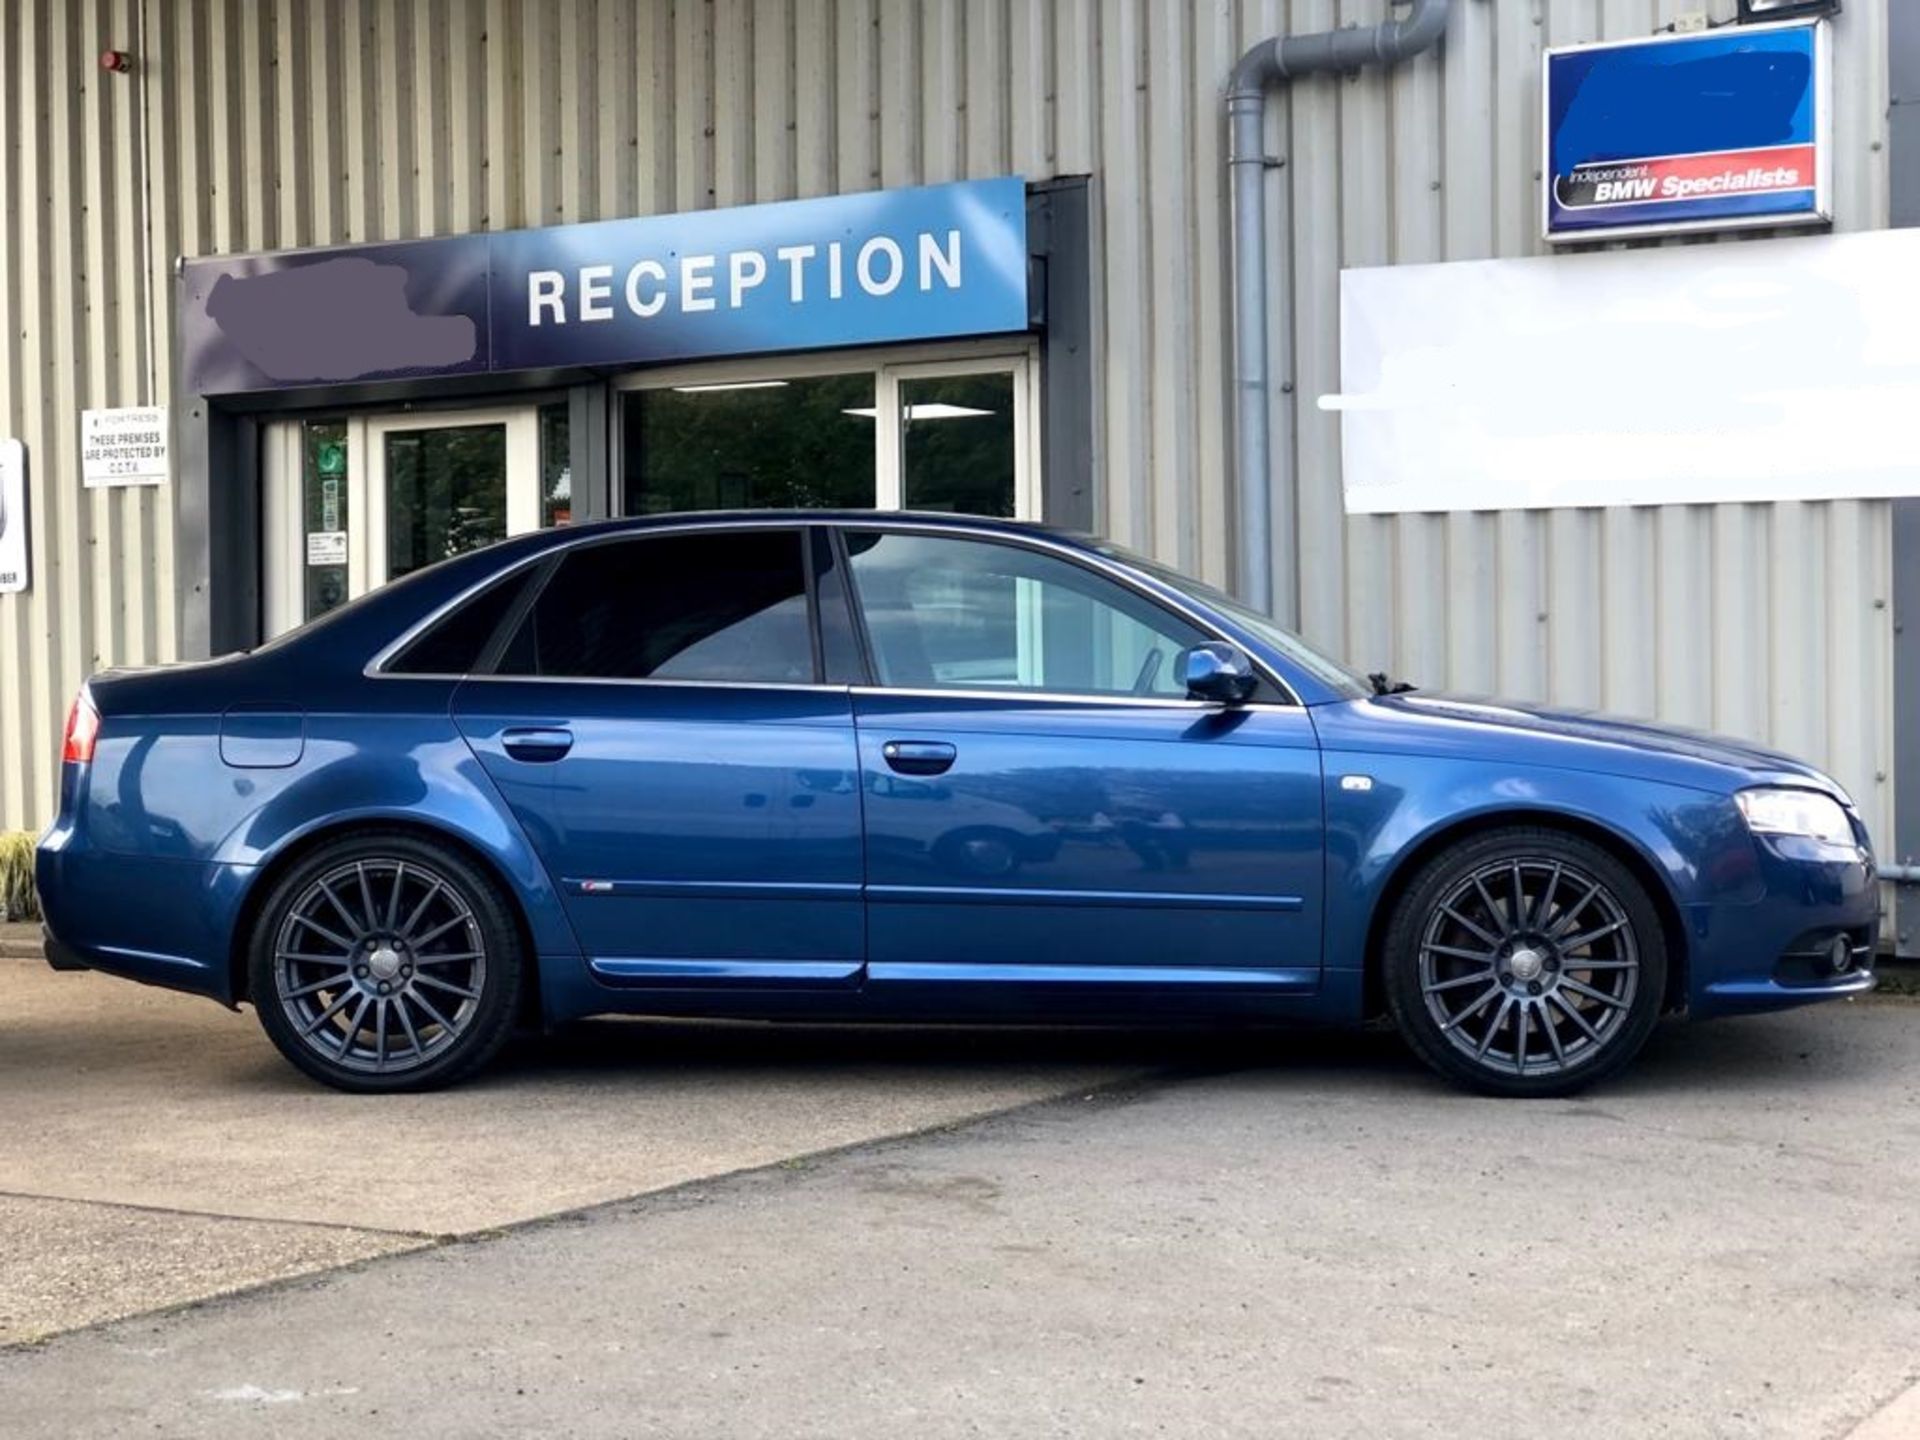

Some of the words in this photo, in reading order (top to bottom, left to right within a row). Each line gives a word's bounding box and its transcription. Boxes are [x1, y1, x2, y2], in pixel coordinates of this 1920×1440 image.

[1569, 165, 1648, 184] Independent
[1594, 178, 1658, 202] BMW
[1661, 167, 1798, 198] Specialists
[528, 230, 961, 327] RECEPTION
[89, 433, 116, 446] THESE
[117, 431, 160, 445] PREMISES
[85, 449, 101, 460] ARE
[103, 446, 152, 459] PROTECTED
[154, 445, 166, 458] BY
